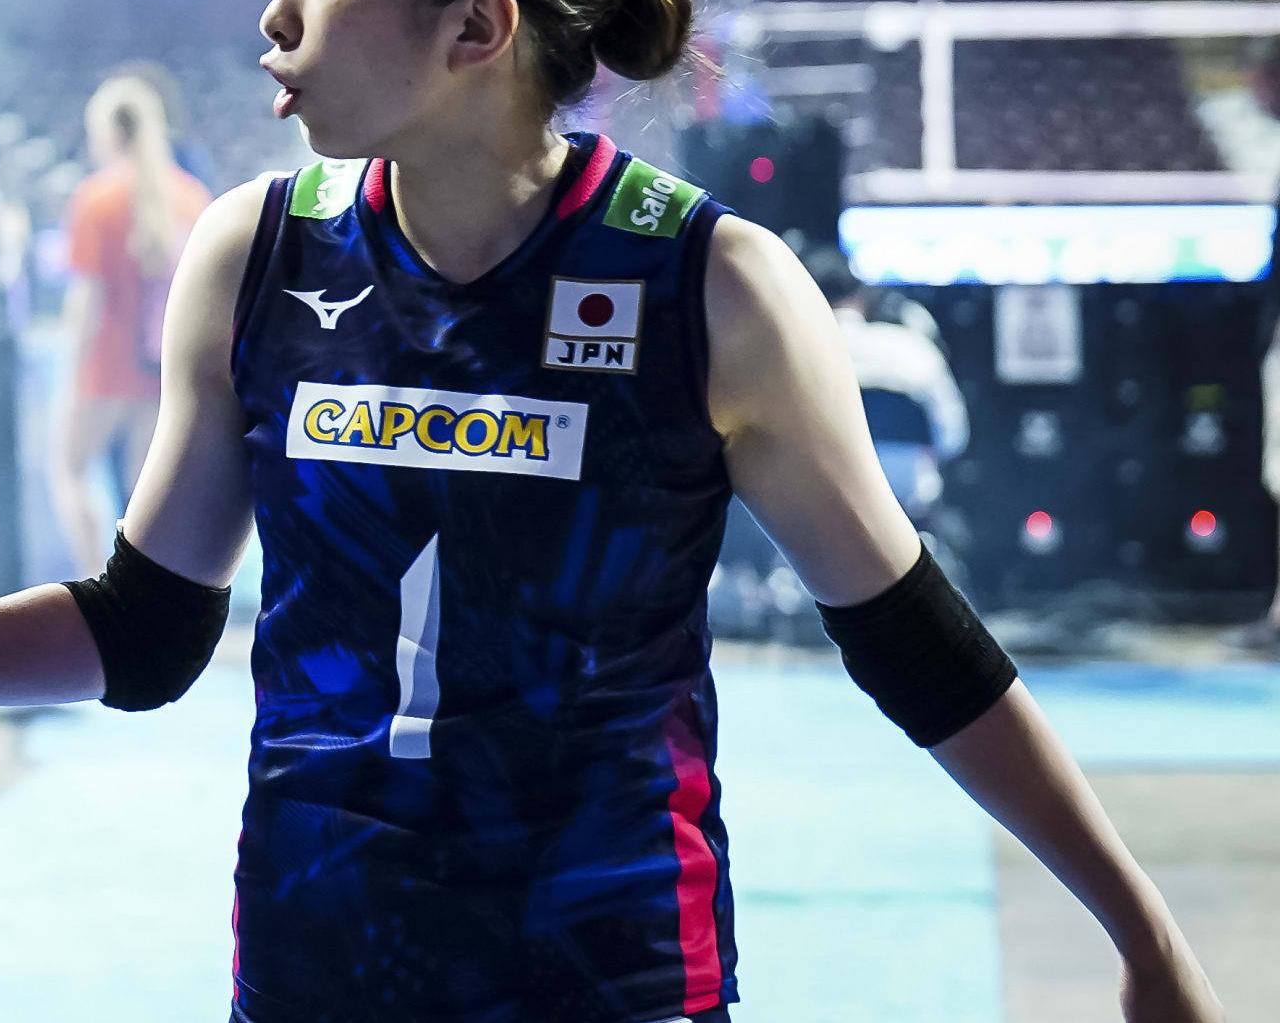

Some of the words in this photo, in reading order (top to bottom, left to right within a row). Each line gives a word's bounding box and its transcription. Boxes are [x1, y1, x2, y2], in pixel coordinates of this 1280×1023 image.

[630, 176, 677, 232] Salo
[557, 341, 625, 366] JPN
[389, 532, 440, 759] 1
